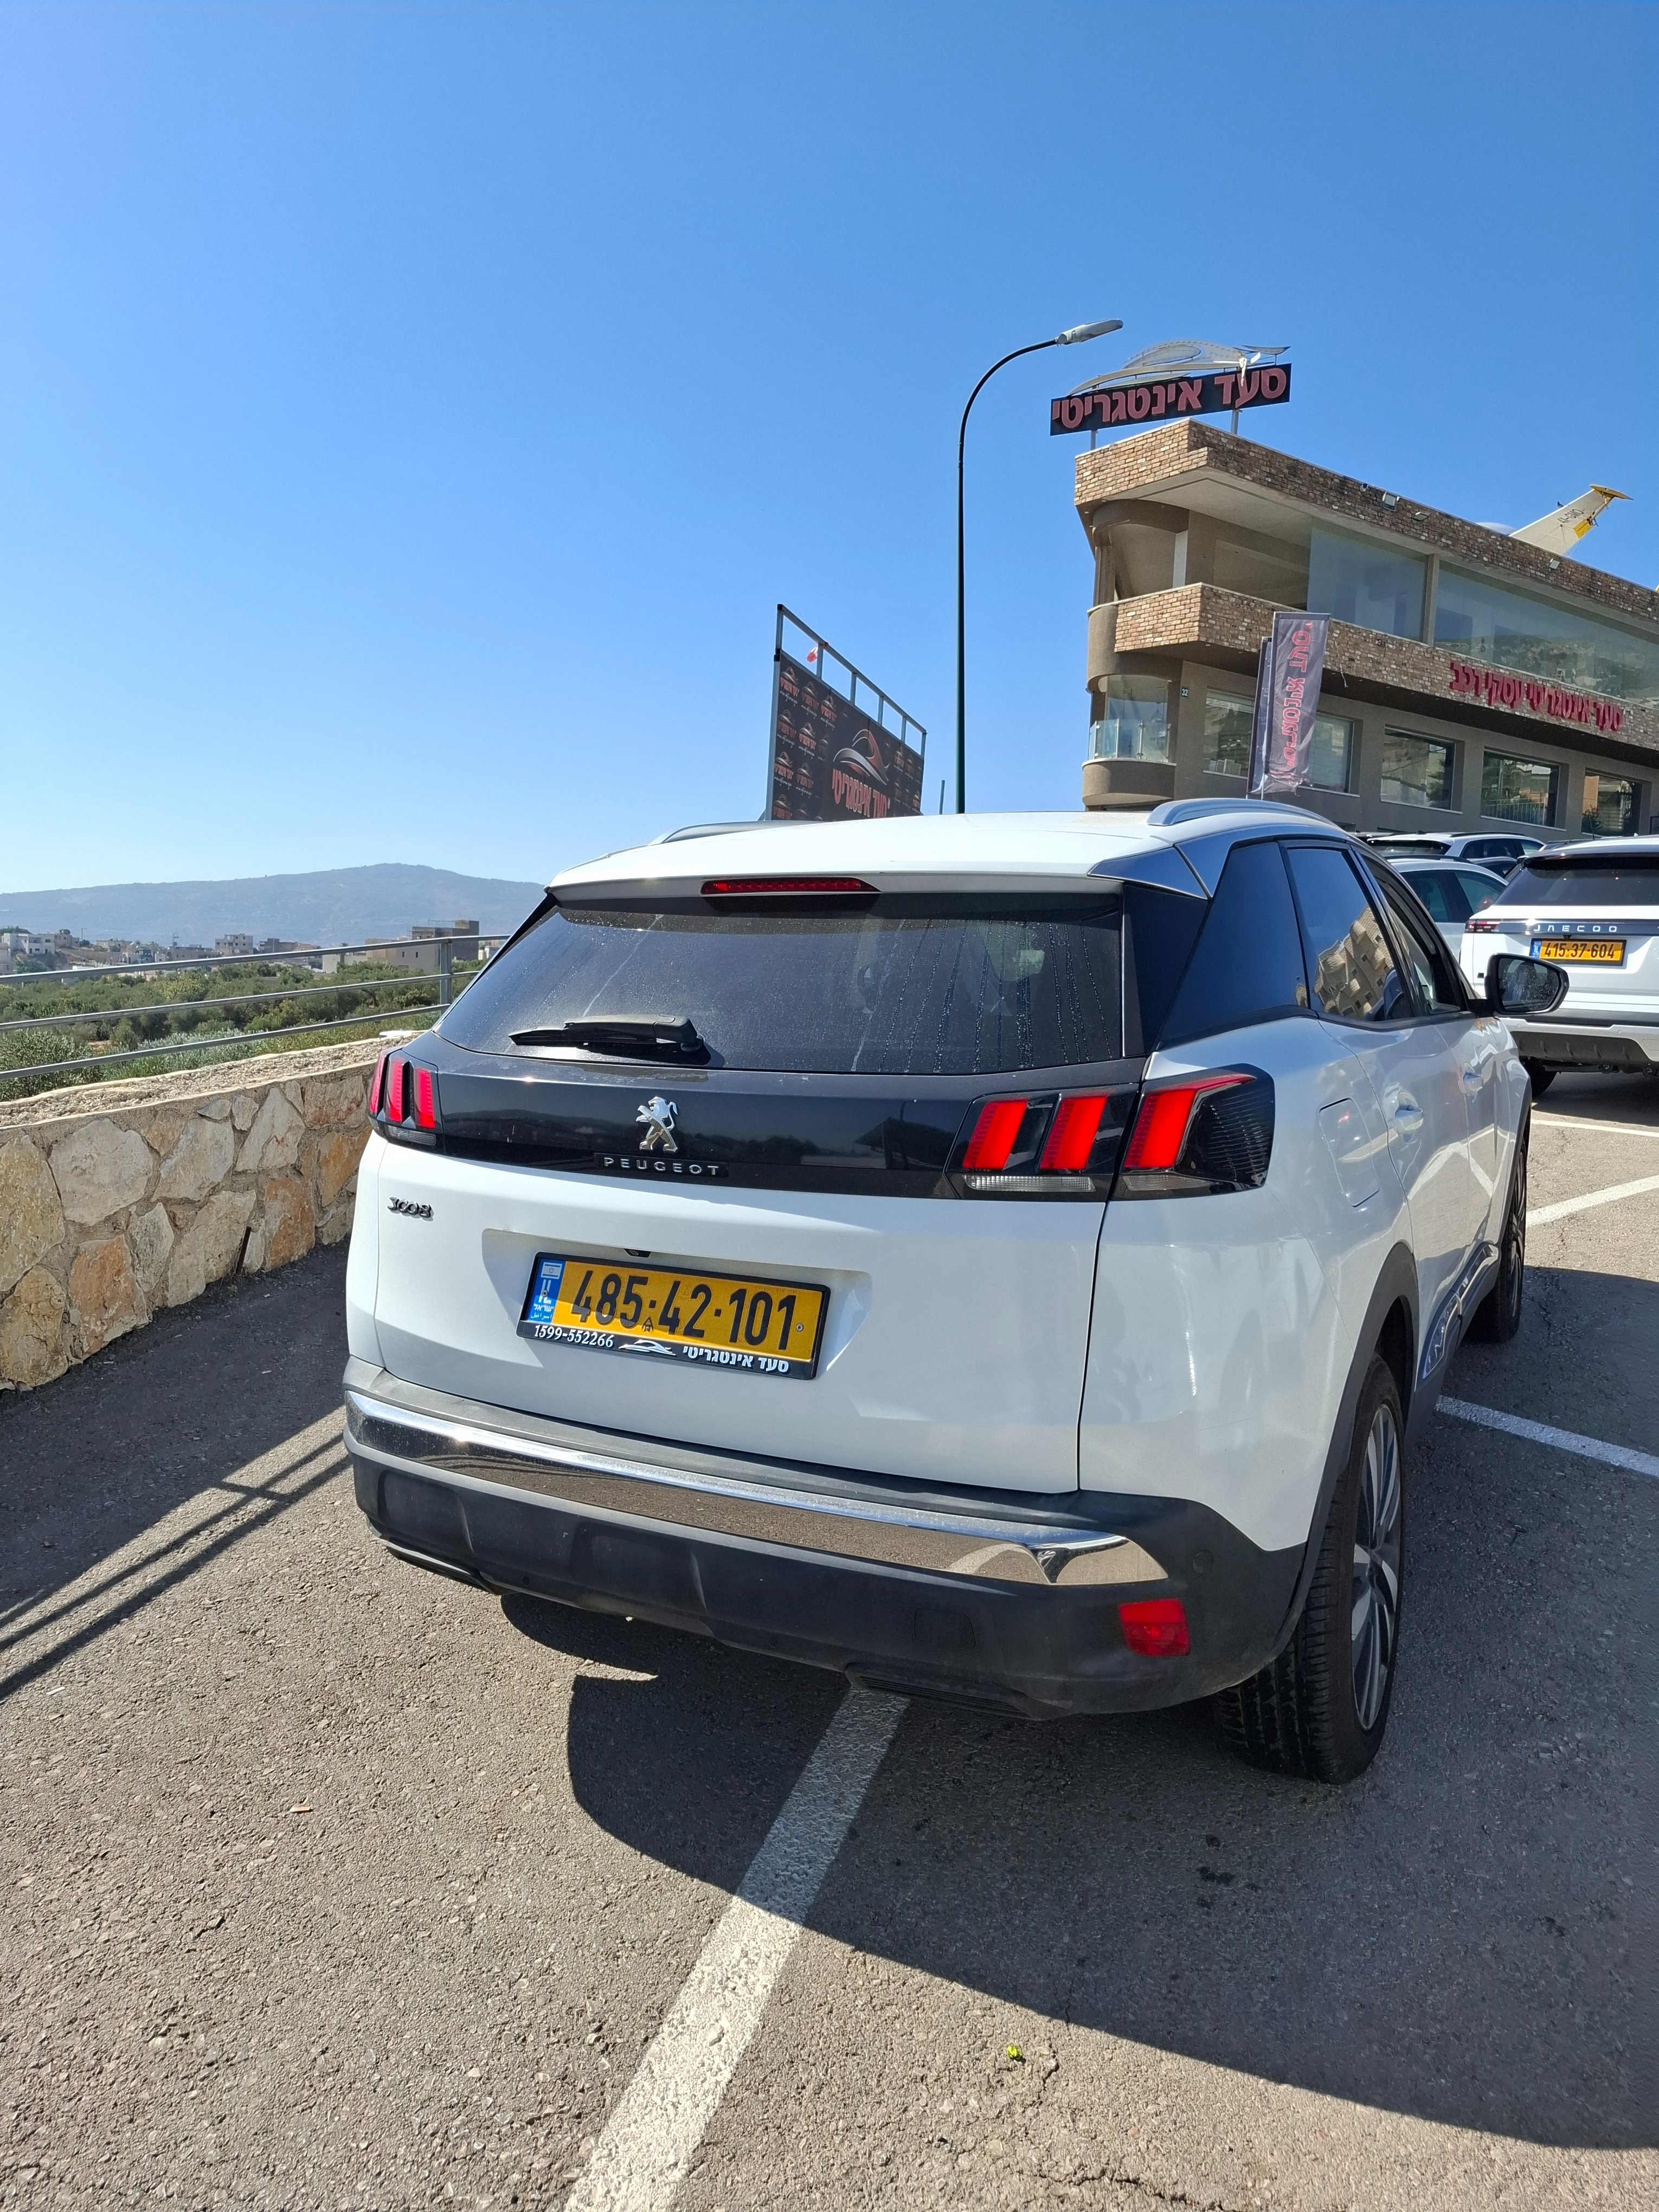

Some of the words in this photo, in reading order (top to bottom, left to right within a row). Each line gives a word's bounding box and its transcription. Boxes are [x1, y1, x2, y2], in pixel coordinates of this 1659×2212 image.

[1214, 368, 1287, 409] סעד
[1052, 379, 1202, 428] אינטגריטי
[1449, 662, 1482, 697] רכב
[1486, 672, 1525, 709] עסקי
[1526, 683, 1590, 723] אינטגריטי
[1593, 701, 1623, 731] סעד
[1533, 924, 1617, 933] JAECOO
[604, 1157, 719, 1175] PEUGEOT
[387, 1197, 432, 1218] 3008
[533, 1303, 554, 1312] ישראל
[535, 1324, 613, 1348] 1599-552266
[683, 1346, 754, 1368] אינטגריטי
[758, 1356, 789, 1372] סעד
